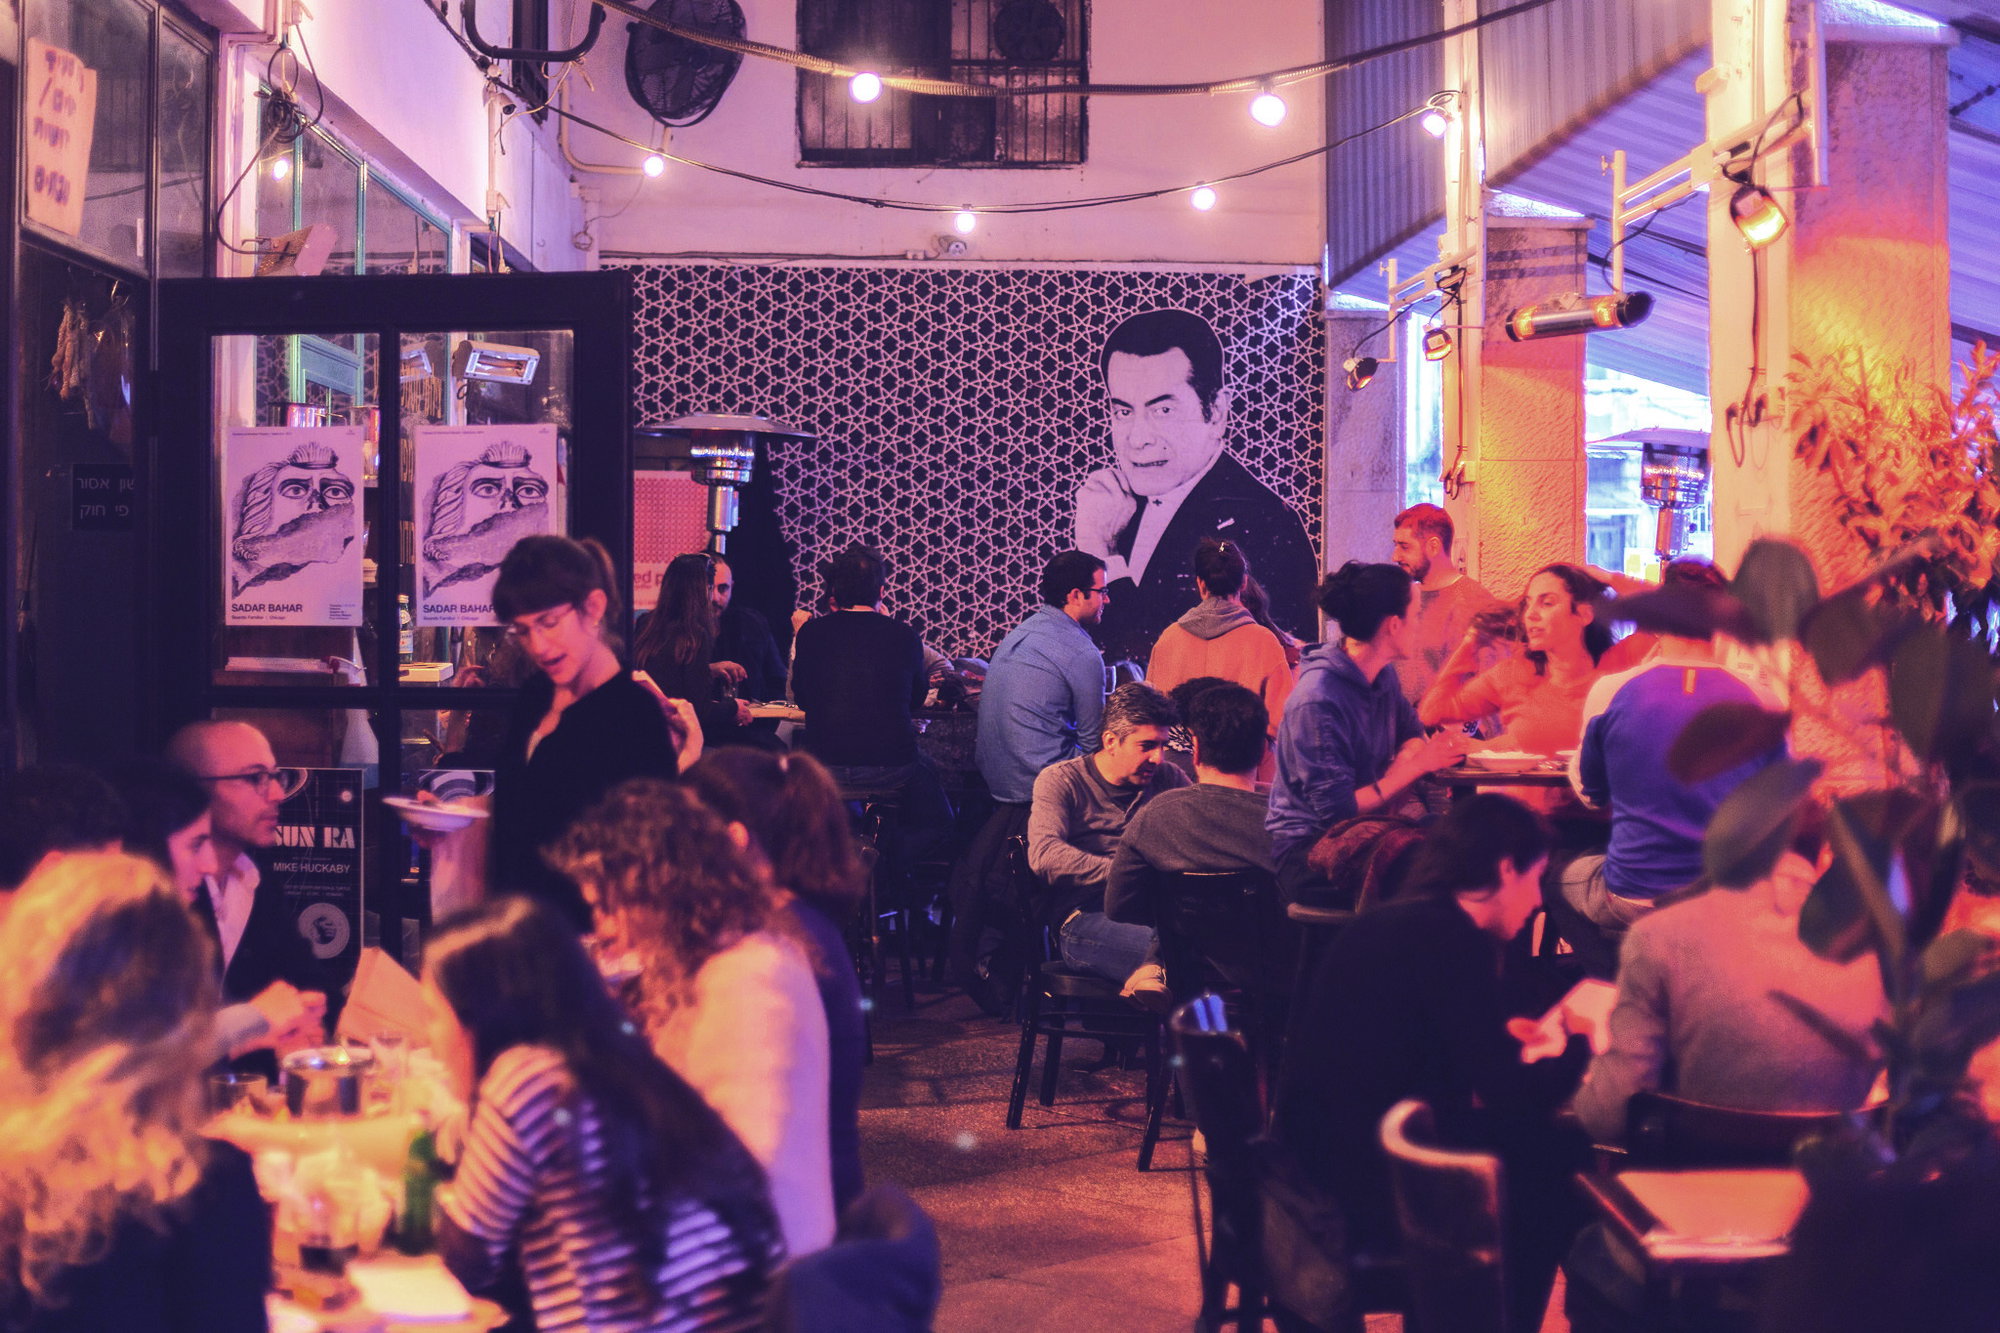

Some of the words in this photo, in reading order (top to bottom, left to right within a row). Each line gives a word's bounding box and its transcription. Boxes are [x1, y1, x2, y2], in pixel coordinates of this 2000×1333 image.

[76, 478, 109, 489] אסור
[119, 478, 135, 493] שון
[80, 504, 106, 520] חוק
[231, 603, 266, 613] SADAR
[268, 603, 303, 613] BAHAR
[423, 604, 457, 613] SADAR
[324, 827, 355, 848] RA
[274, 862, 298, 872] MIKE
[300, 863, 350, 873] HUCKABY
